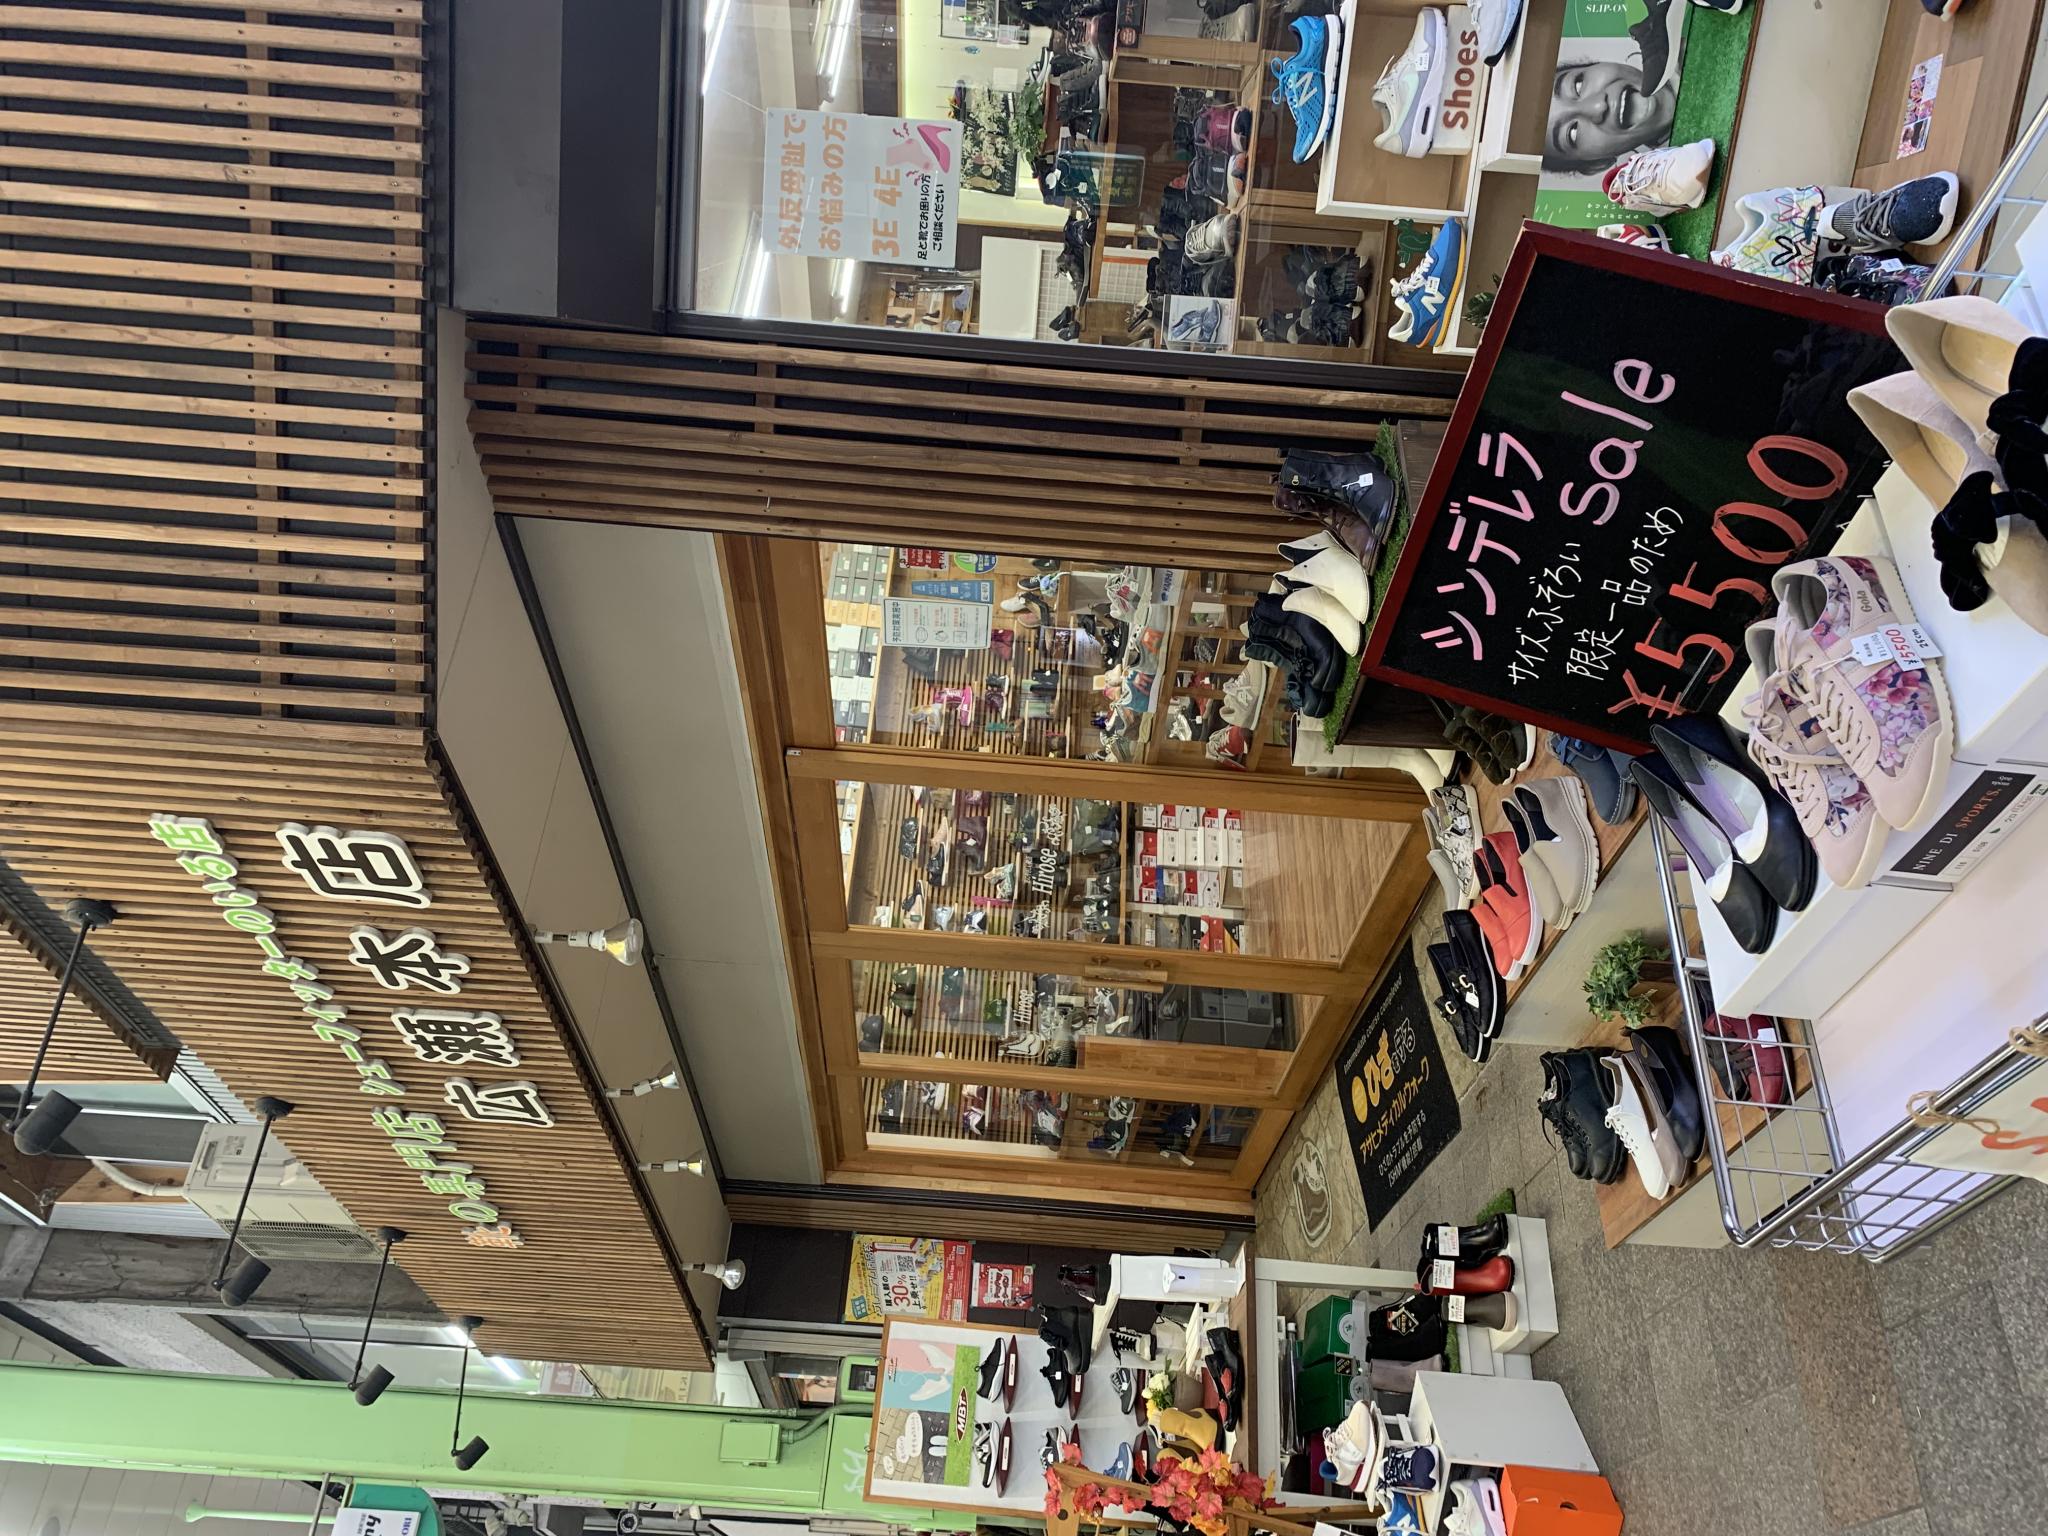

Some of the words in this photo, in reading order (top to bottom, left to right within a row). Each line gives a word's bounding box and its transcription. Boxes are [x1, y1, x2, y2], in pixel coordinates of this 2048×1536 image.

[1442, 30, 1479, 130] Shoes
[778, 114, 806, 249] 外反母趾で
[818, 115, 847, 252] お悩みの方
[873, 166, 902, 207] 4E
[917, 173, 931, 260] 足と靴でお困りの方
[932, 183, 945, 252] ご相談ください
[872, 218, 899, 258] 3E
[1421, 432, 1543, 660] シンデレラ
[1607, 435, 1848, 719] ¥5500
[892, 601, 901, 643] 予防対策実施中
[1508, 542, 1581, 685] サイズふぞろい
[1566, 506, 1683, 680] 限定一品のため
[1857, 590, 1873, 612] Gola
[1885, 629, 1919, 665] ¥5500
[1912, 628, 1928, 649] 25cm
[1031, 848, 1057, 895] Hirose
[1913, 848, 1943, 870] NINE
[1939, 833, 1958, 844] DI
[148, 814, 407, 1095] シューフィッターのいる店
[275, 823, 555, 1127] 広瀬本店
[1013, 989, 1034, 1024] Hirose
[1360, 1055, 1430, 1164] アサヒメディカルウォーク
[372, 1106, 524, 1248] 靴の専門店
[891, 1275, 911, 1307] 30%
[957, 1397, 967, 1433] MBT
